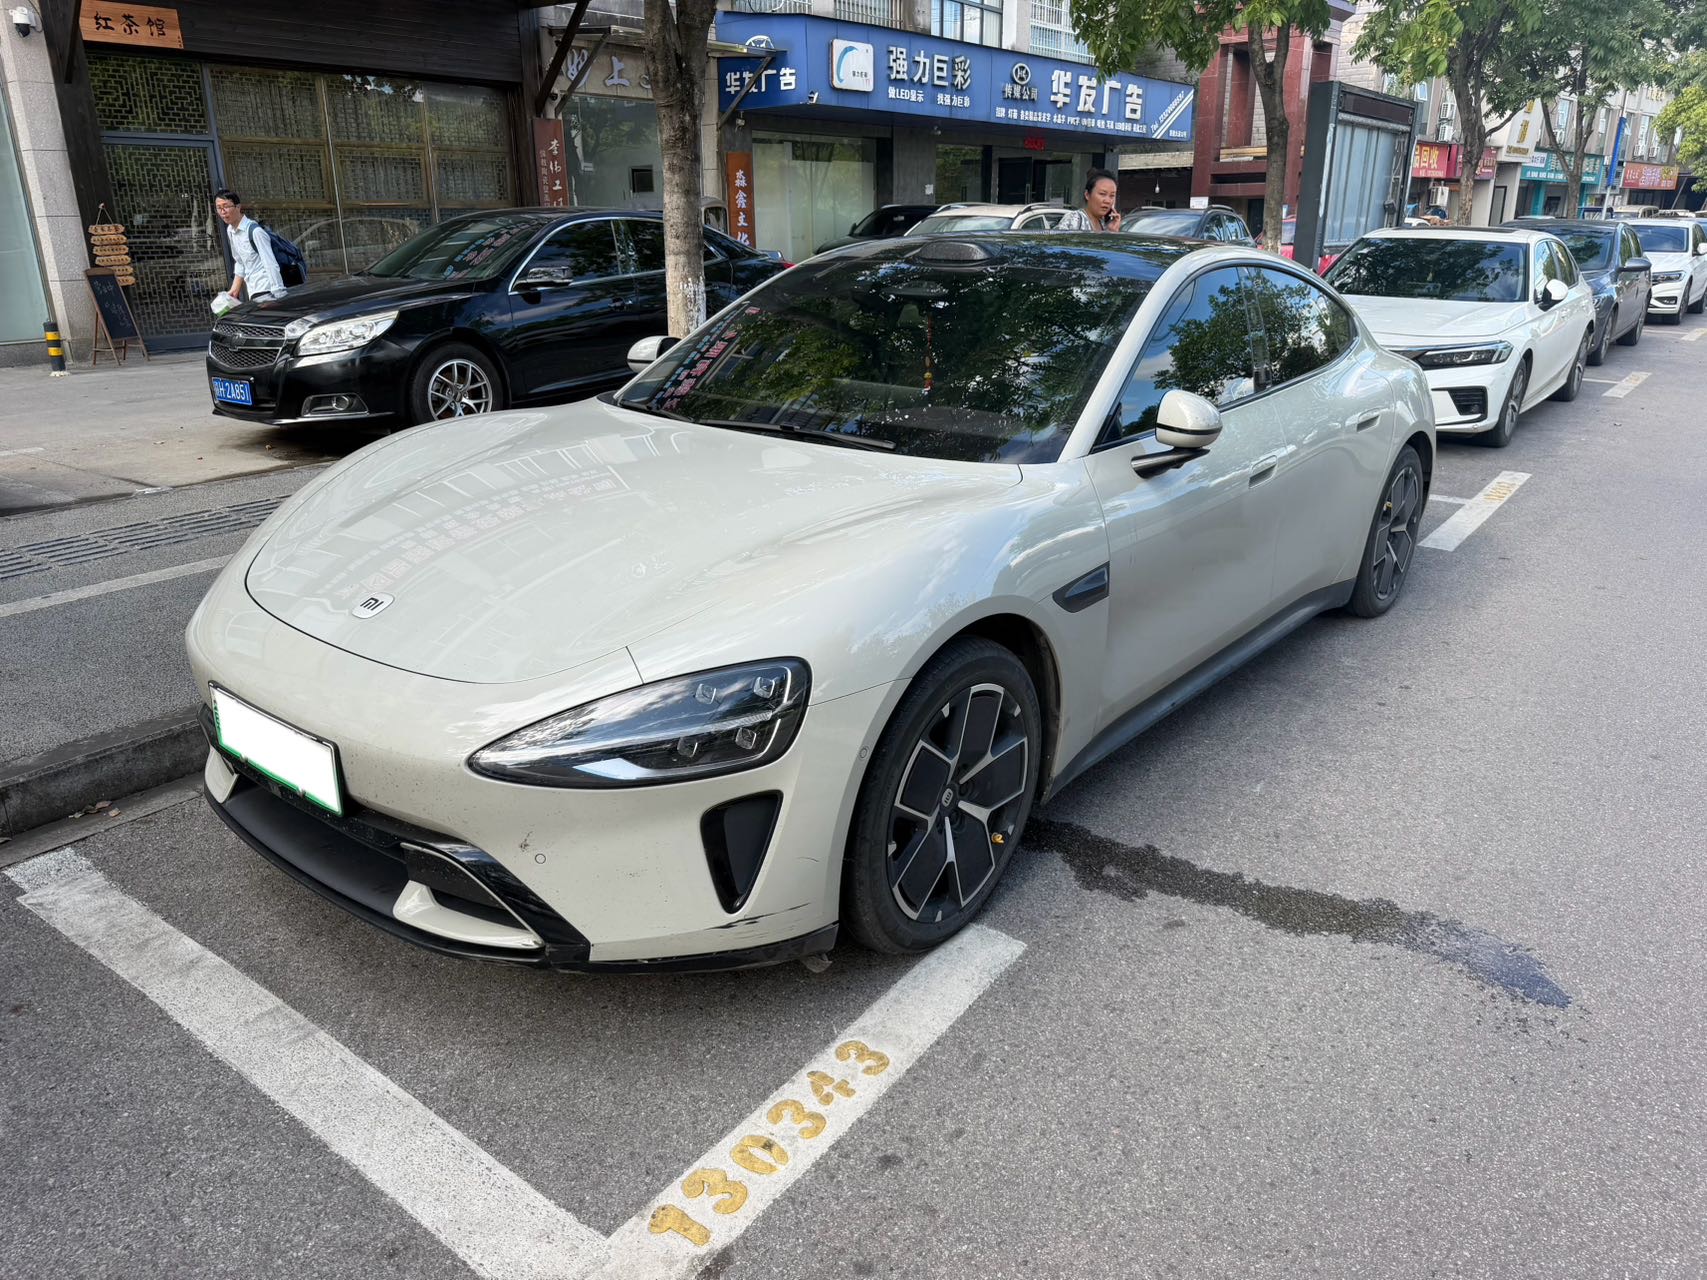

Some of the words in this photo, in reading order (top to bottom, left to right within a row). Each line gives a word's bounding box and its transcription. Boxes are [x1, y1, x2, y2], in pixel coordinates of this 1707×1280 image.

[94, 11, 166, 37] 红茶馆
[725, 67, 796, 94] 华发广告
[888, 46, 971, 90] 强力巨彩
[888, 86, 924, 103] 做LED显示
[937, 93, 970, 108] 找强力巨彩
[1050, 69, 1143, 120] 华发广告
[648, 1040, 890, 1246] 130343
